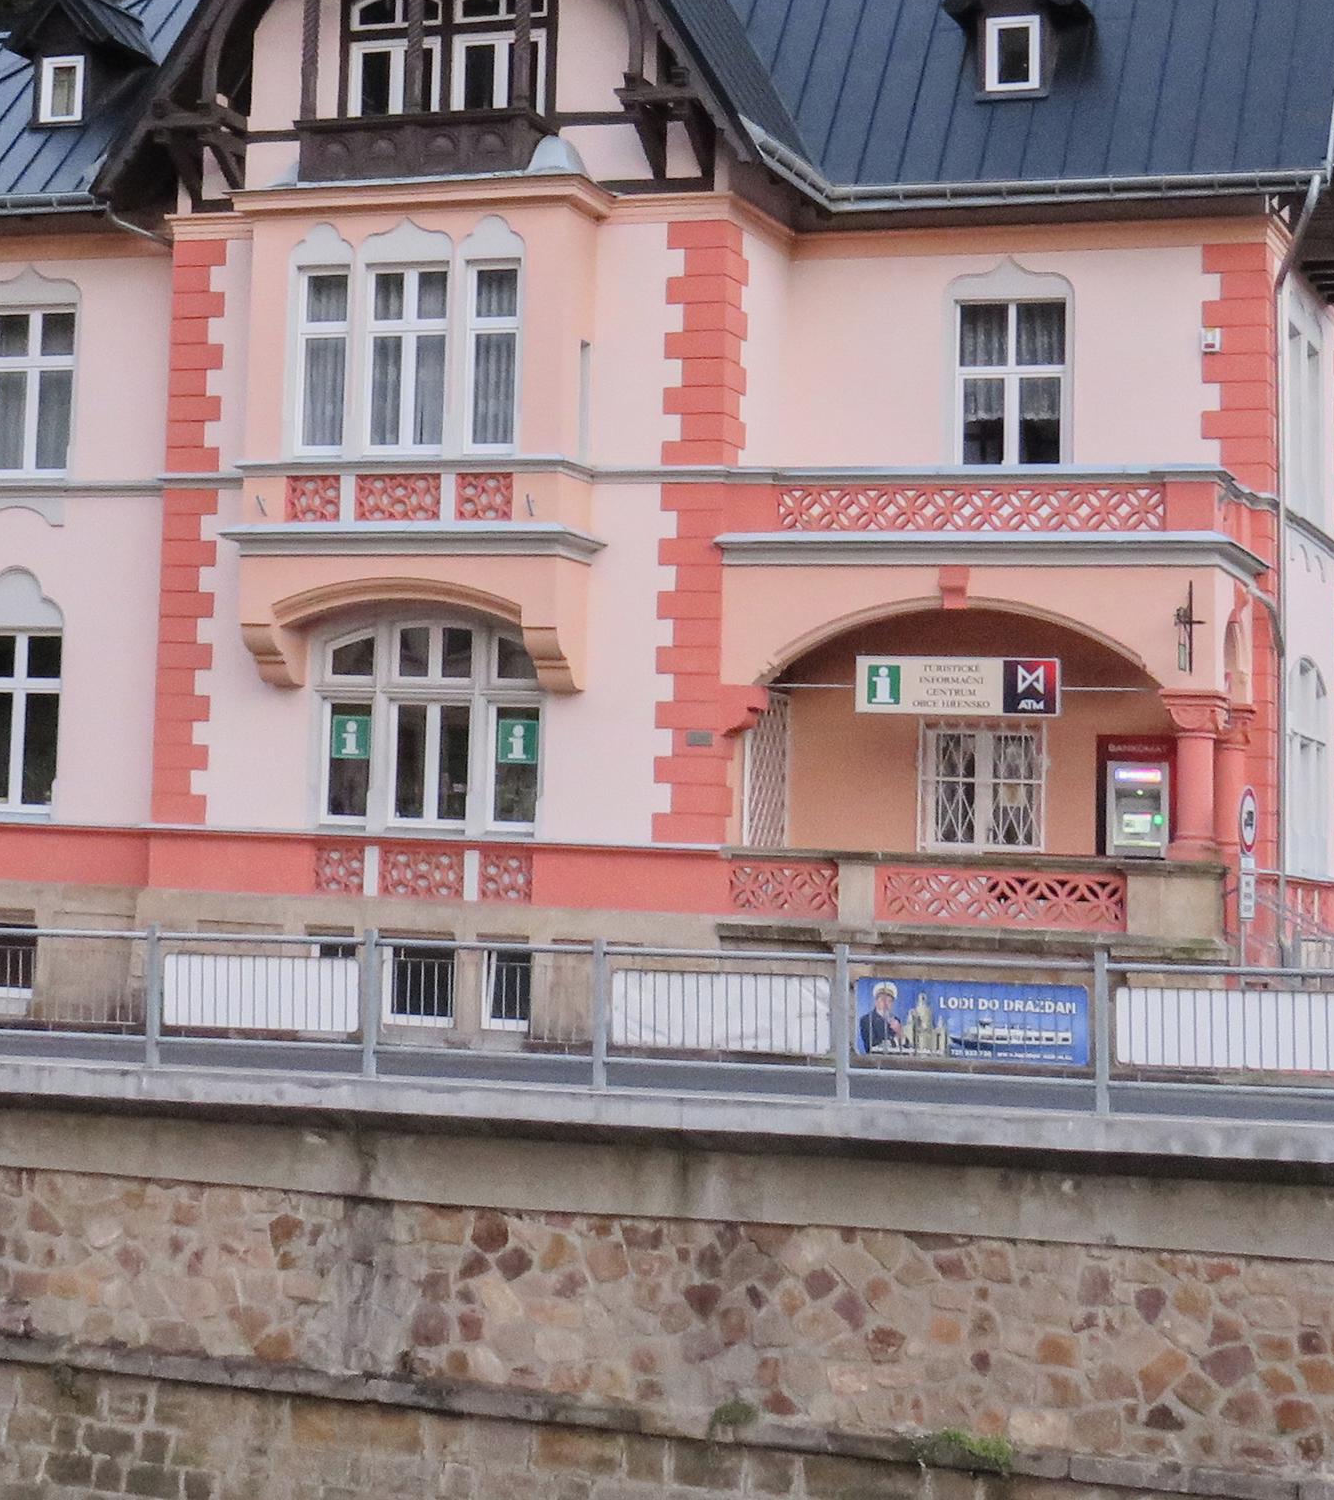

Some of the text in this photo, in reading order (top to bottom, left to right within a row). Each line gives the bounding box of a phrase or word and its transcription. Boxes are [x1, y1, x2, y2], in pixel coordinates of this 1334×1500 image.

[926, 688, 977, 697] CENTRUM
[912, 700, 936, 708] OBCE
[1018, 699, 1044, 710] ATM
[978, 998, 999, 1010] DO
